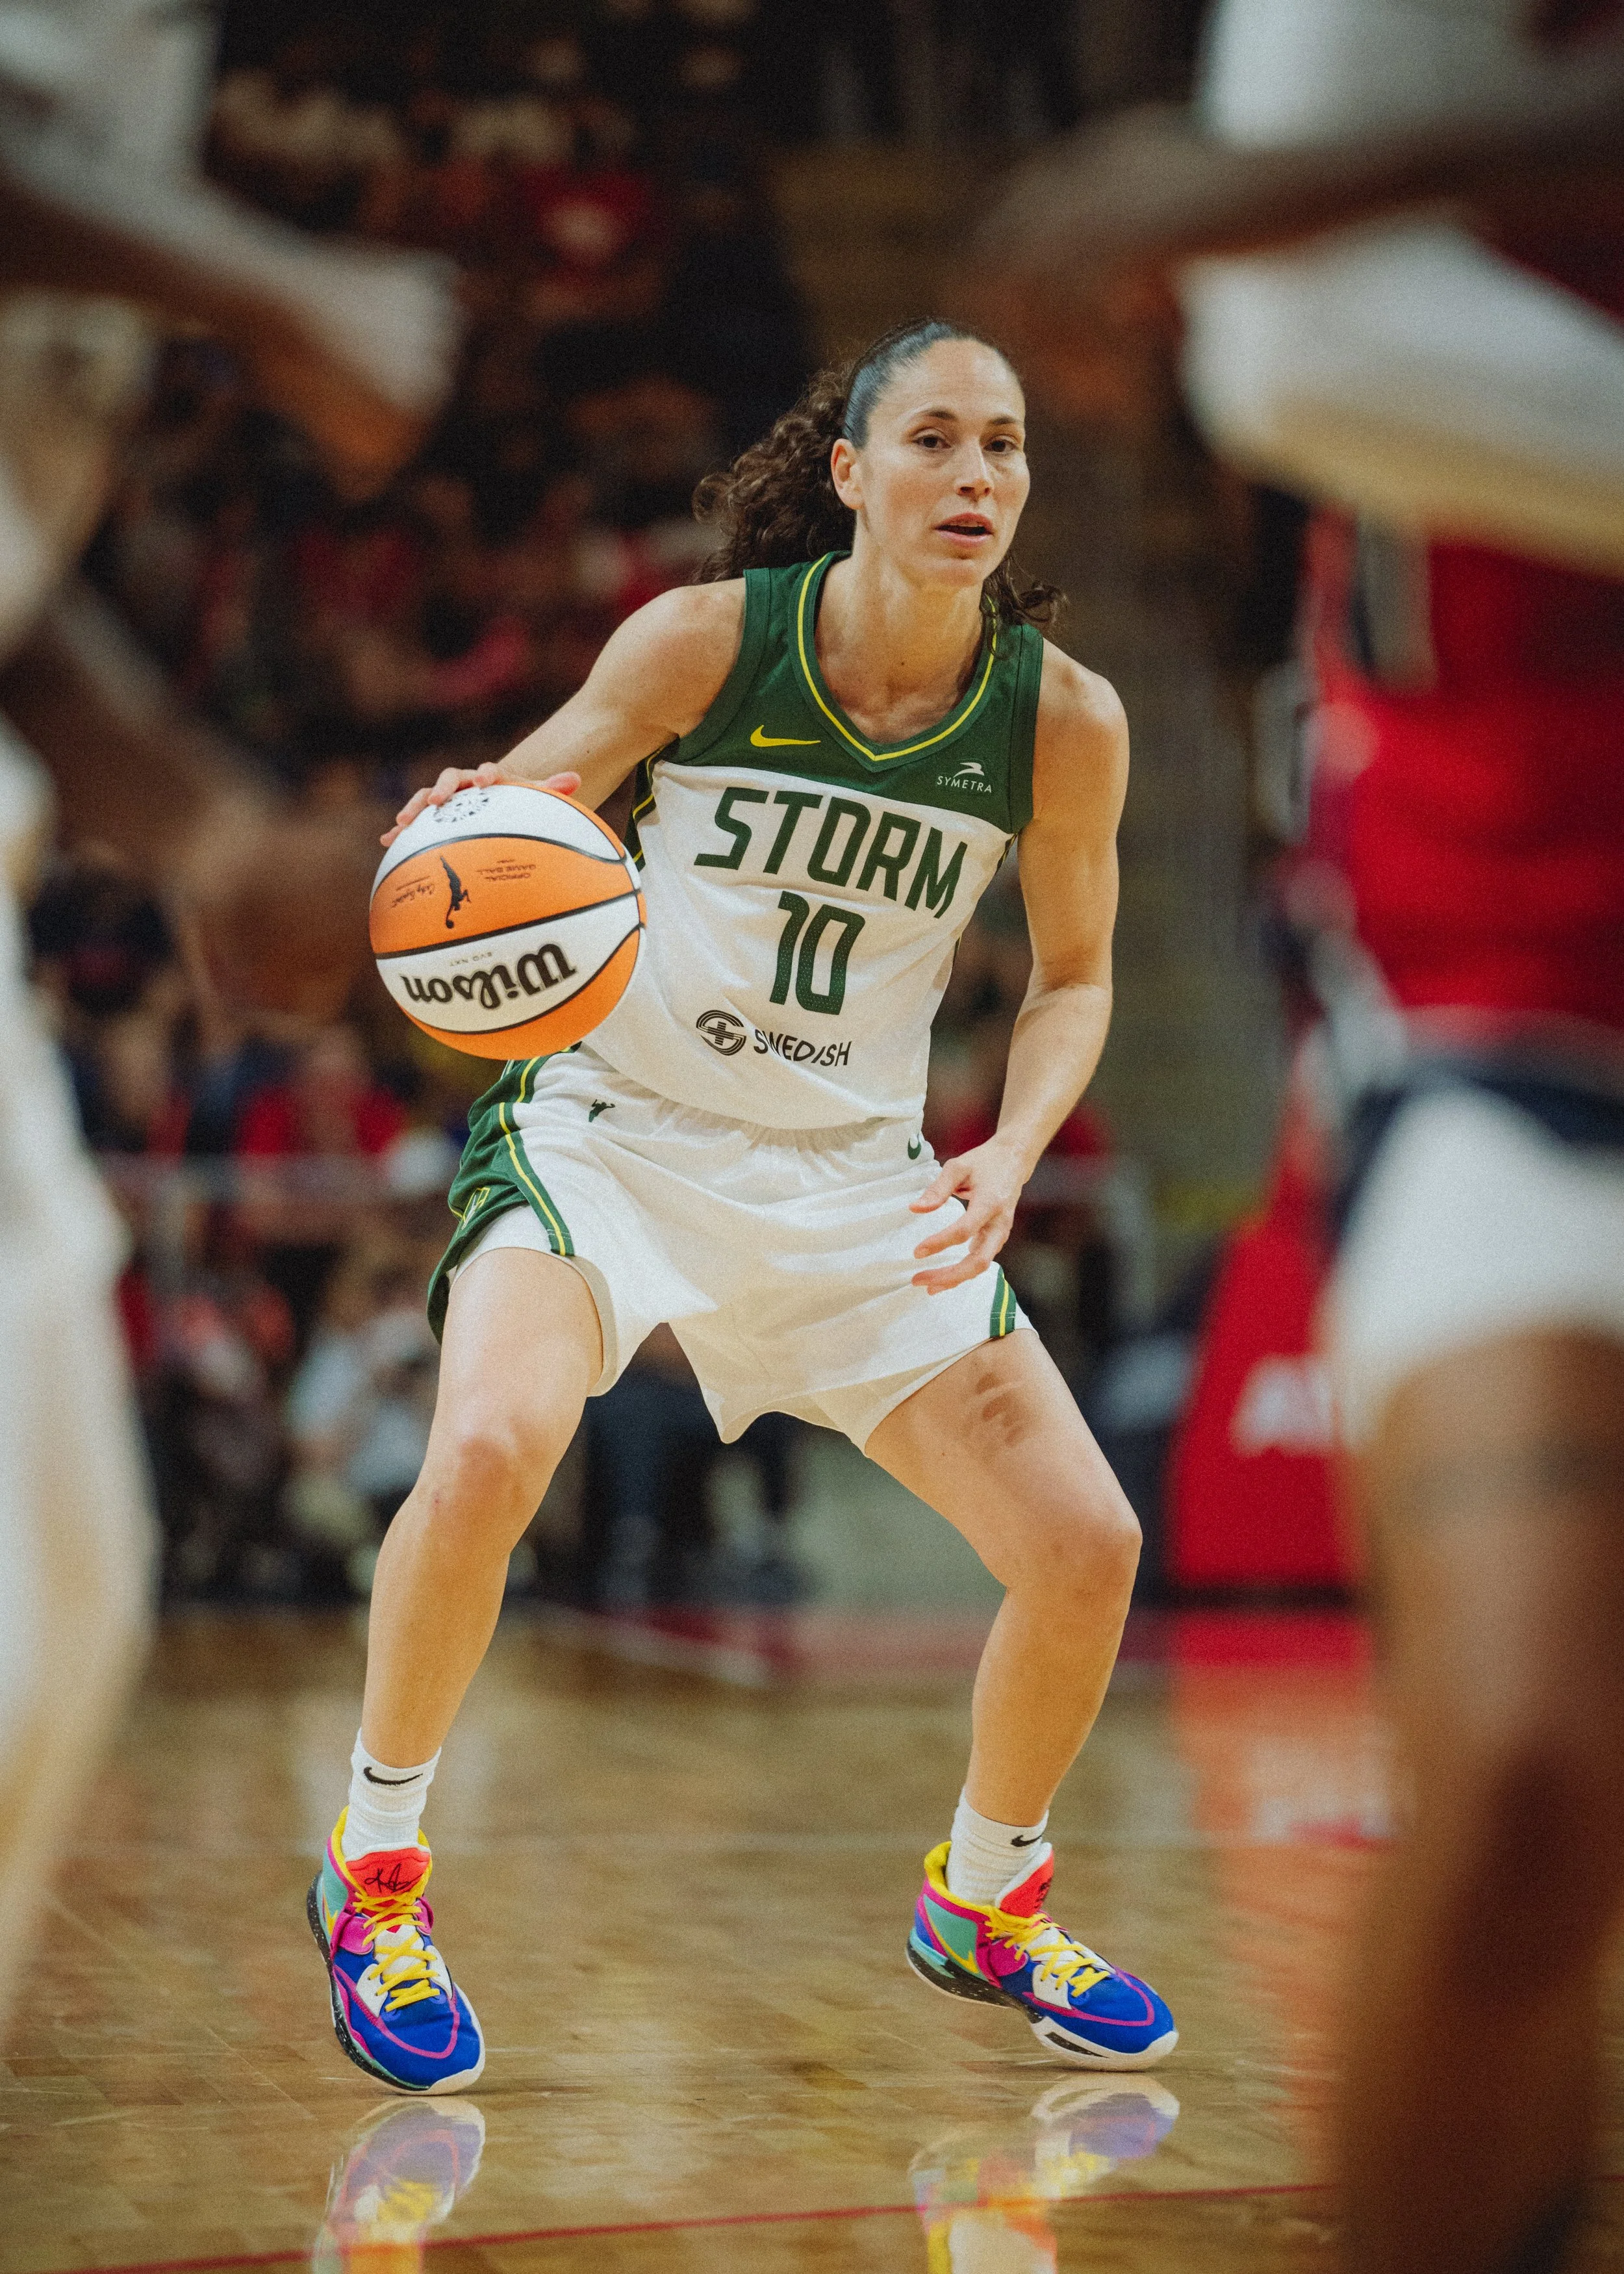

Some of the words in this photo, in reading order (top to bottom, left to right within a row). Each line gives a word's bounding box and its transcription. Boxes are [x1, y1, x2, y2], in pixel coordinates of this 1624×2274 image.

[936, 775, 993, 793] SYMETRA
[694, 786, 968, 919] STORM
[400, 943, 578, 1010] Wilson
[769, 891, 865, 1016] 10
[754, 1028, 852, 1067] SWEDISH
